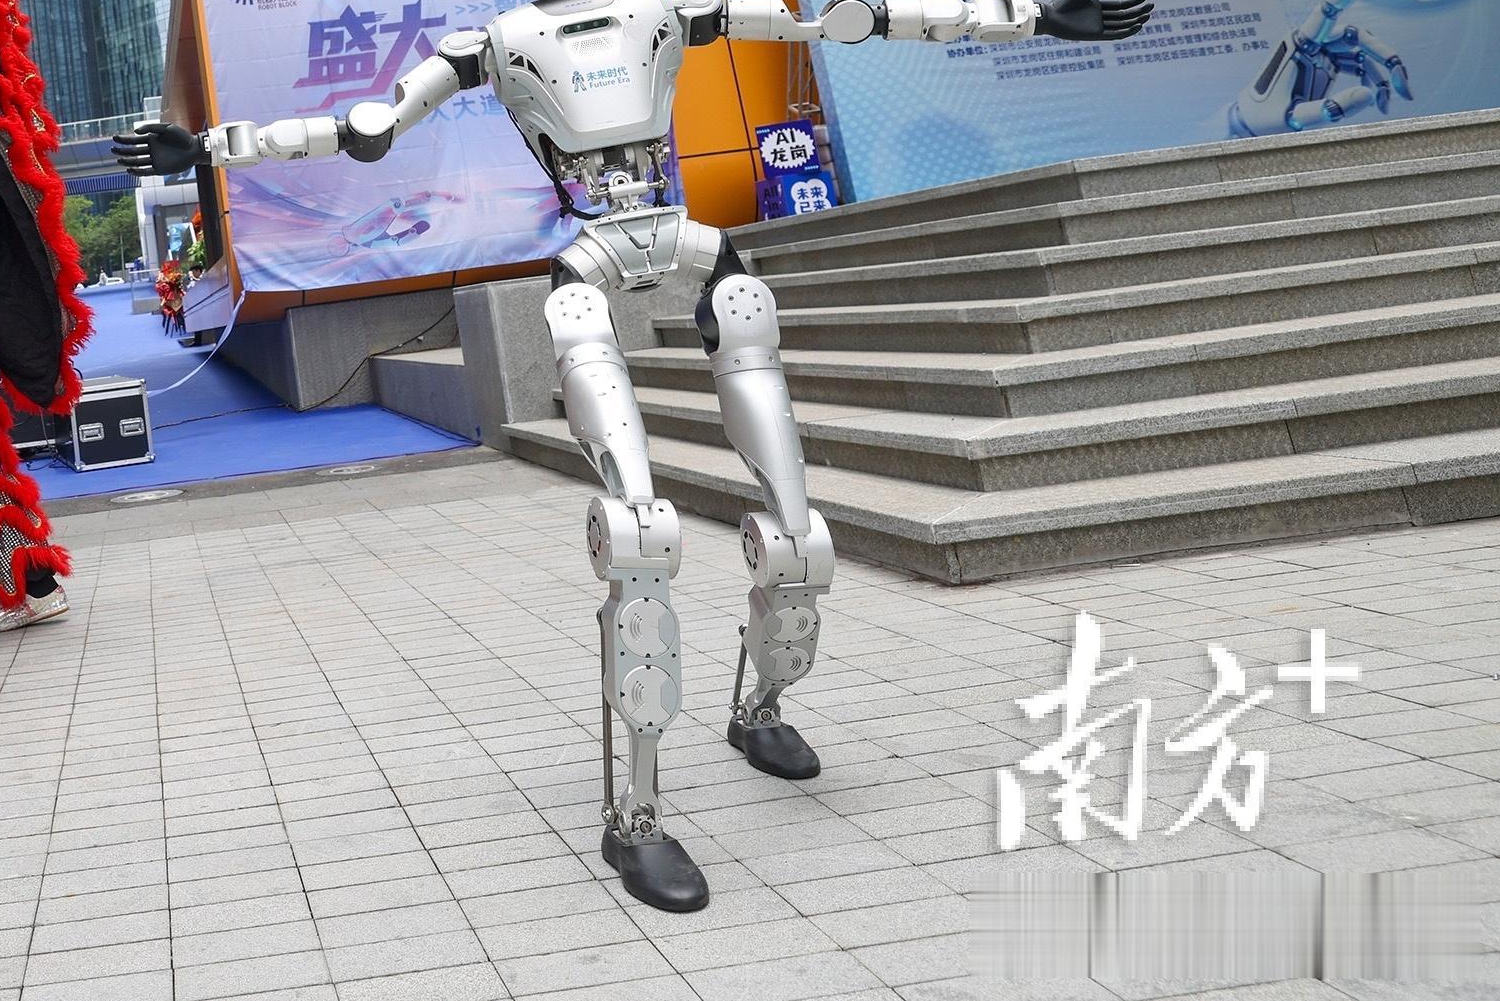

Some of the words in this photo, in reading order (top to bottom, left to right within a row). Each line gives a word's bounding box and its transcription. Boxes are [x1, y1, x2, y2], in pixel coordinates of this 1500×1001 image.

[258, 2, 277, 11] ROBOT
[278, 0, 298, 10] BLOCK
[586, 66, 629, 82] 未来时代
[589, 79, 616, 89] Future
[617, 76, 631, 85] Era
[770, 144, 808, 163] 龙岗
[797, 186, 823, 200] 未来
